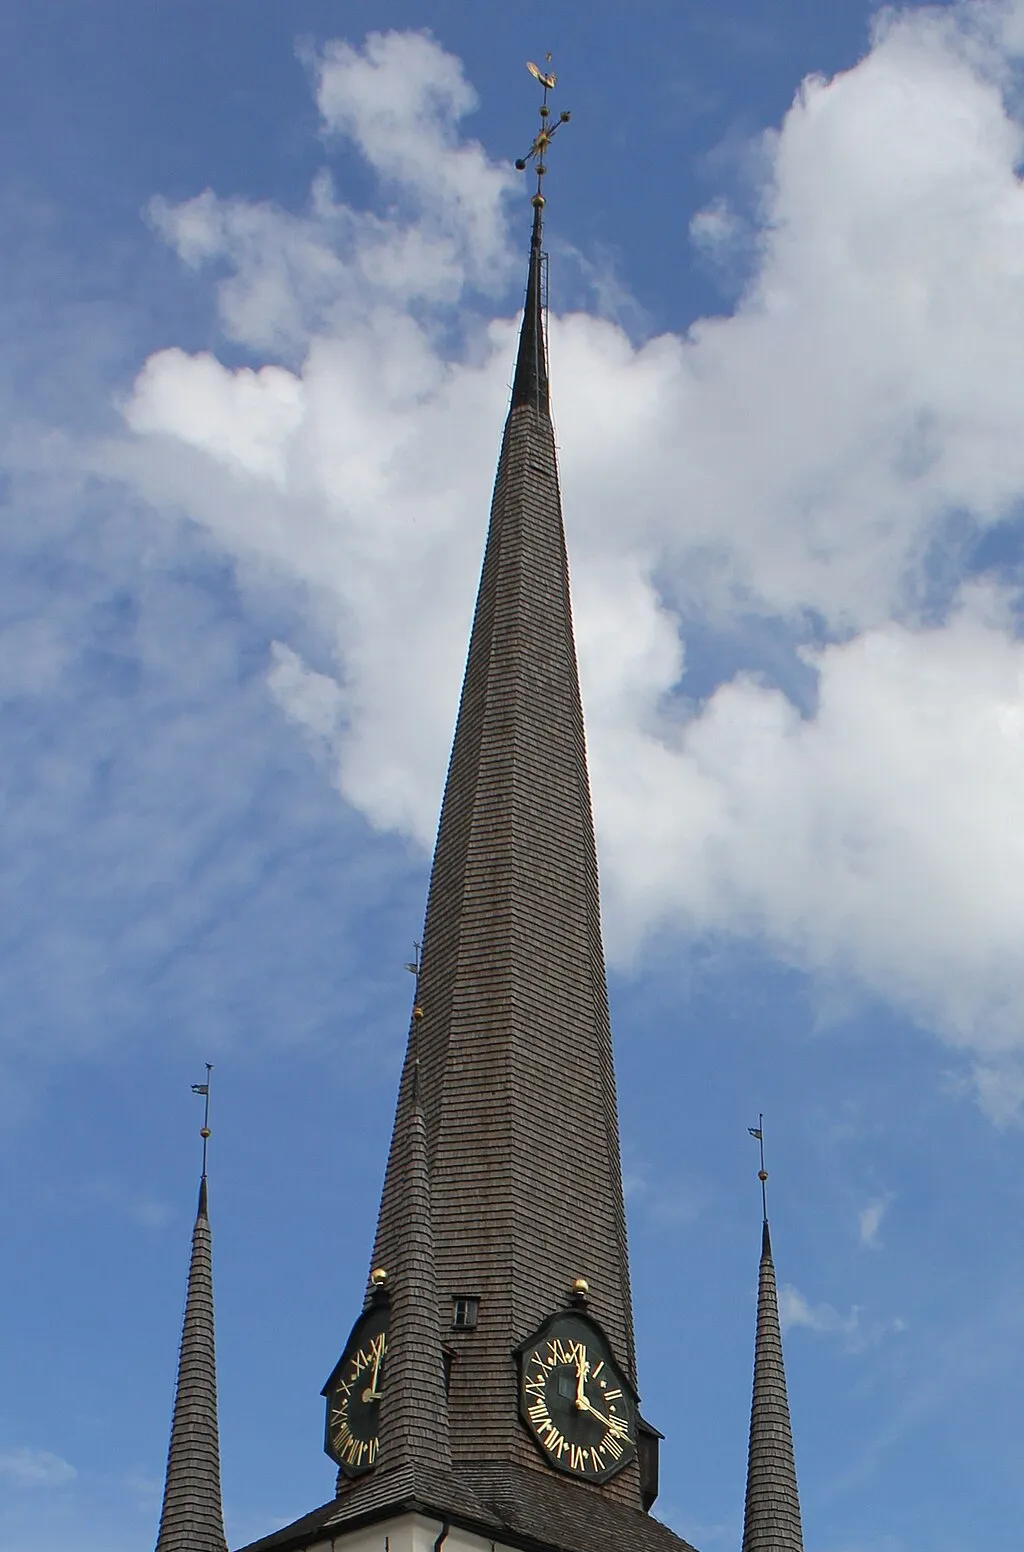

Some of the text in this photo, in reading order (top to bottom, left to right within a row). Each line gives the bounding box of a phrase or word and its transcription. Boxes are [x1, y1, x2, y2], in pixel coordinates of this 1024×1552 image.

[531, 1351, 553, 1378] X
[547, 1339, 568, 1366] XI
[592, 1361, 604, 1379] I
[336, 1379, 354, 1396] X
[526, 1375, 546, 1400] IX
[604, 1389, 623, 1401] II
[544, 1427, 565, 1459] VII
[570, 1444, 586, 1471] VI
[590, 1446, 606, 1472] V
